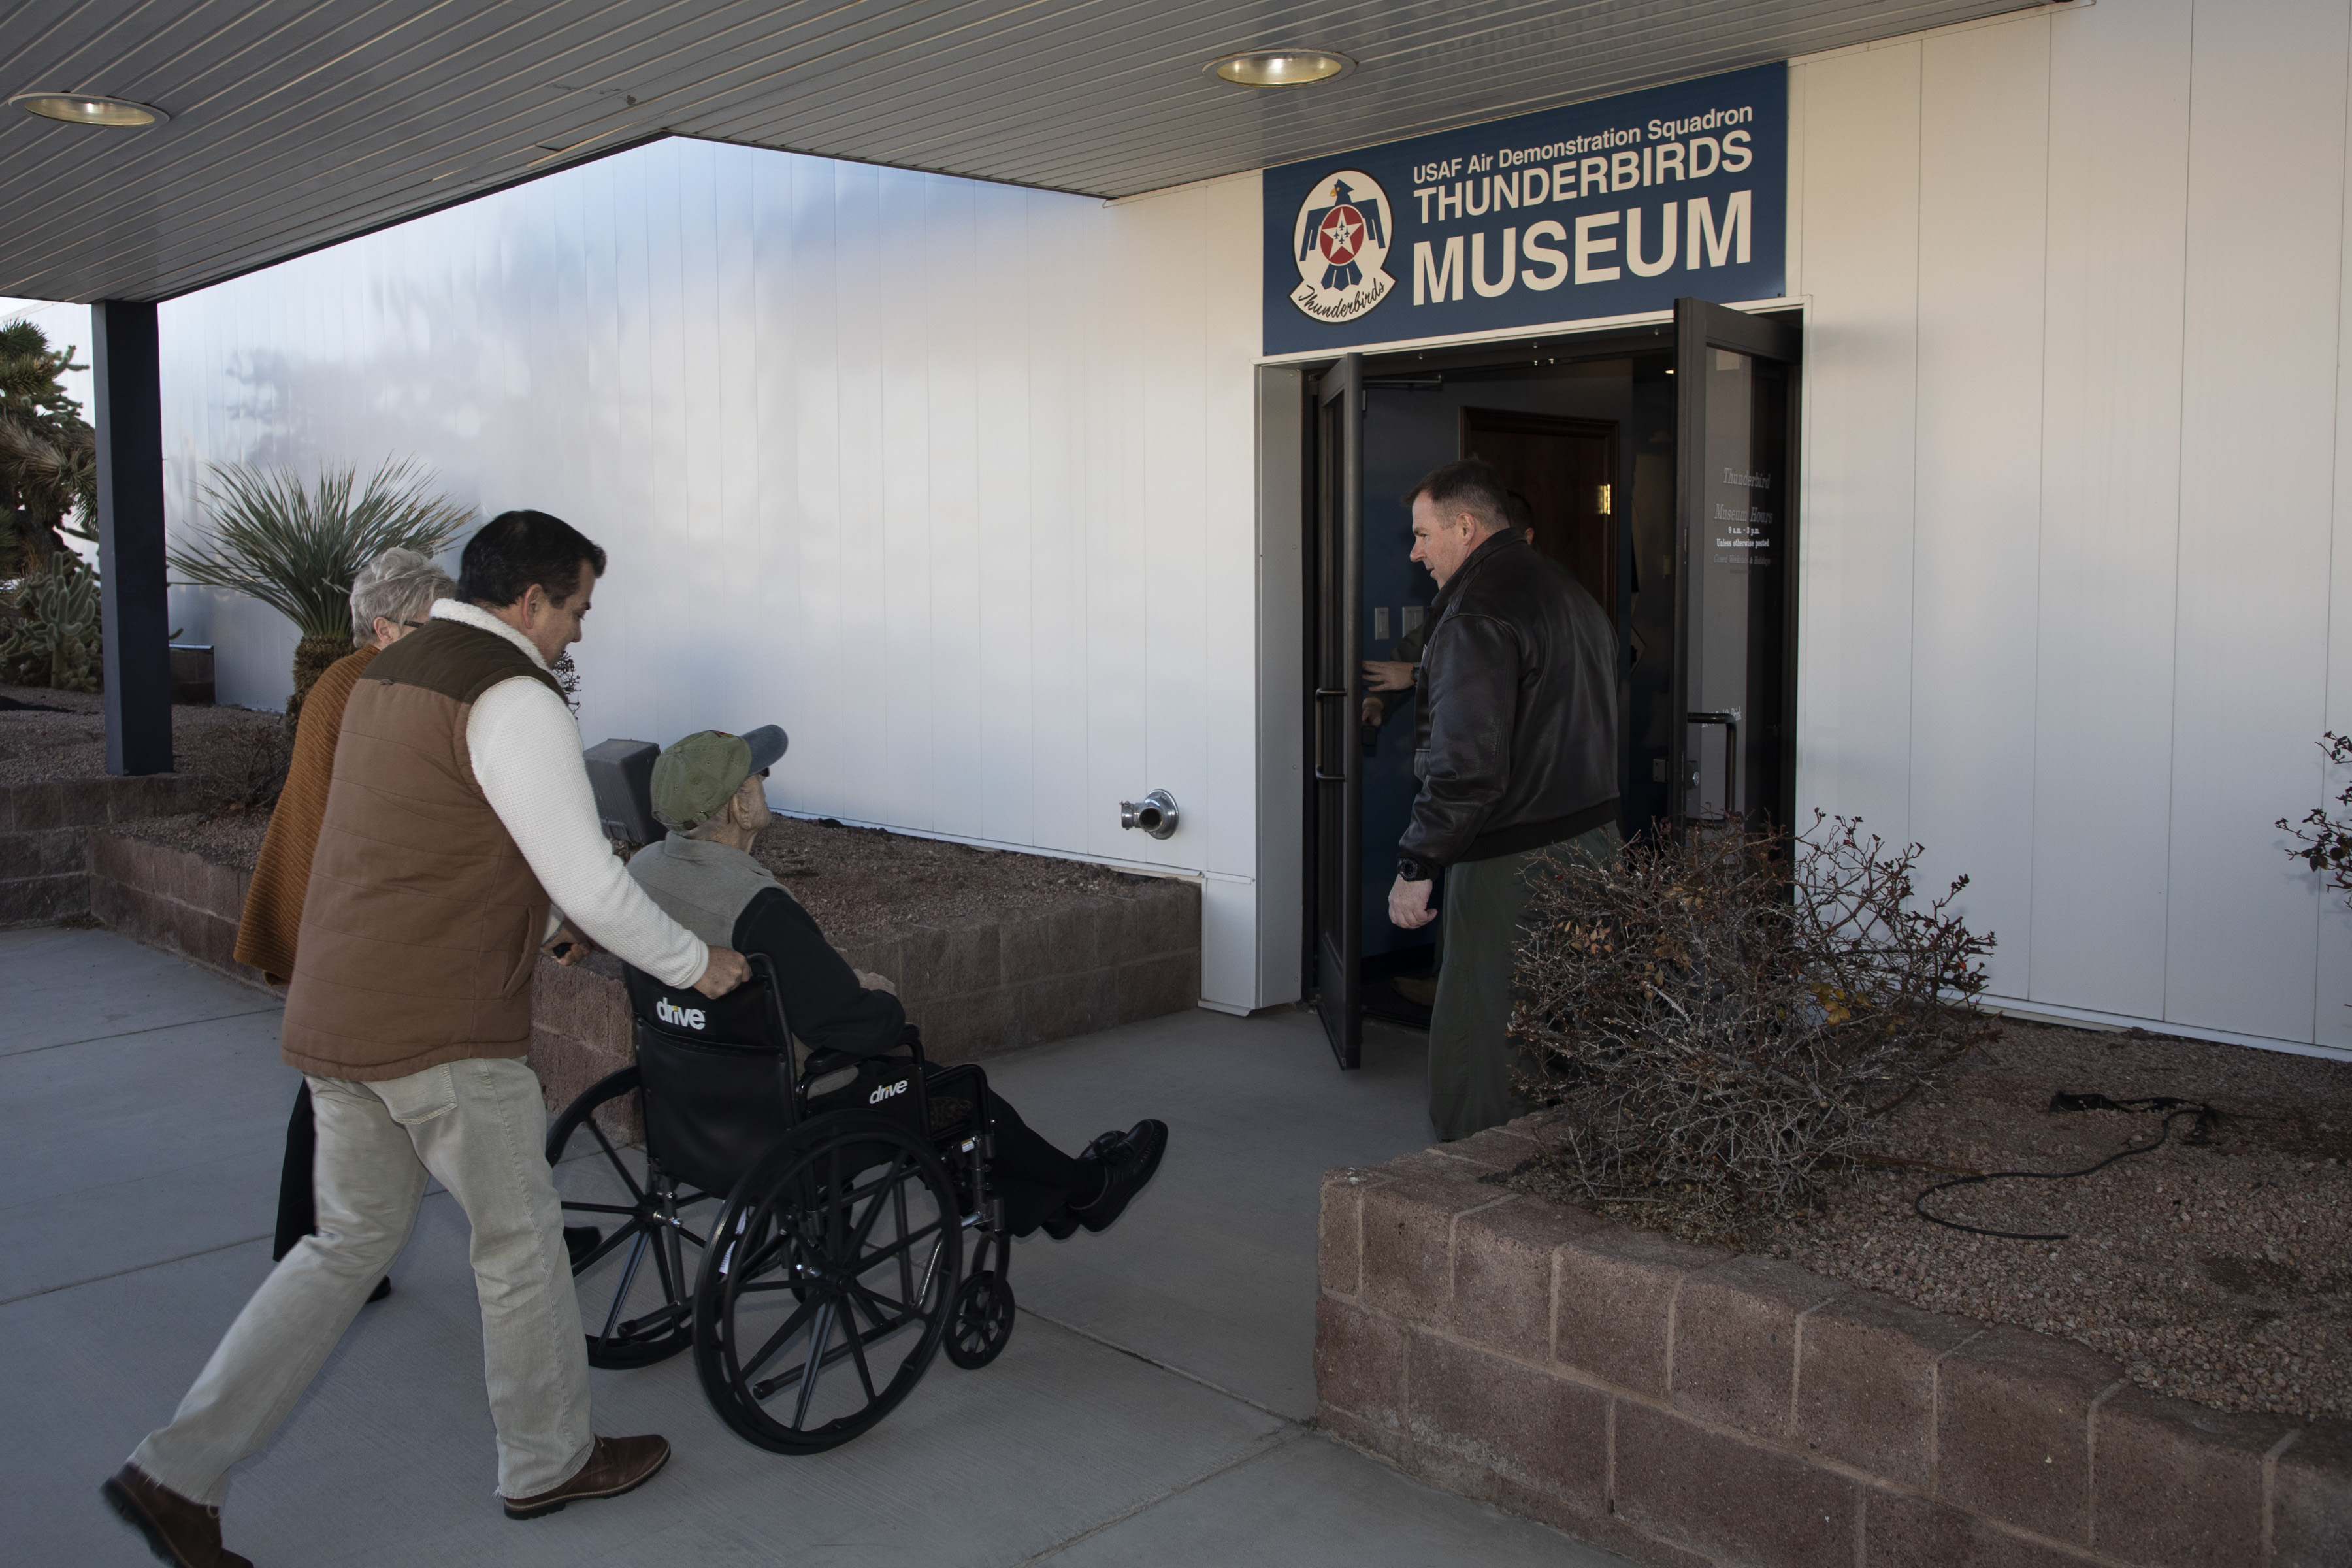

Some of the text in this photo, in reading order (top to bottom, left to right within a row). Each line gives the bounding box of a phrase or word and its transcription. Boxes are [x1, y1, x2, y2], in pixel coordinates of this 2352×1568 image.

[1413, 106, 1753, 184] USAF Air Demonstration Squadron
[1413, 129, 1753, 224] THUNDERBIRDS
[1413, 189, 1752, 306] MUSEUM
[1298, 277, 1385, 318] Thunderbirds
[1723, 467, 1771, 489] Thunderbird
[1714, 503, 1773, 524] Museum Hours
[1716, 538, 1769, 549] Unless otherwise posted
[656, 996, 706, 1030] drive
[869, 1079, 908, 1104] drive
